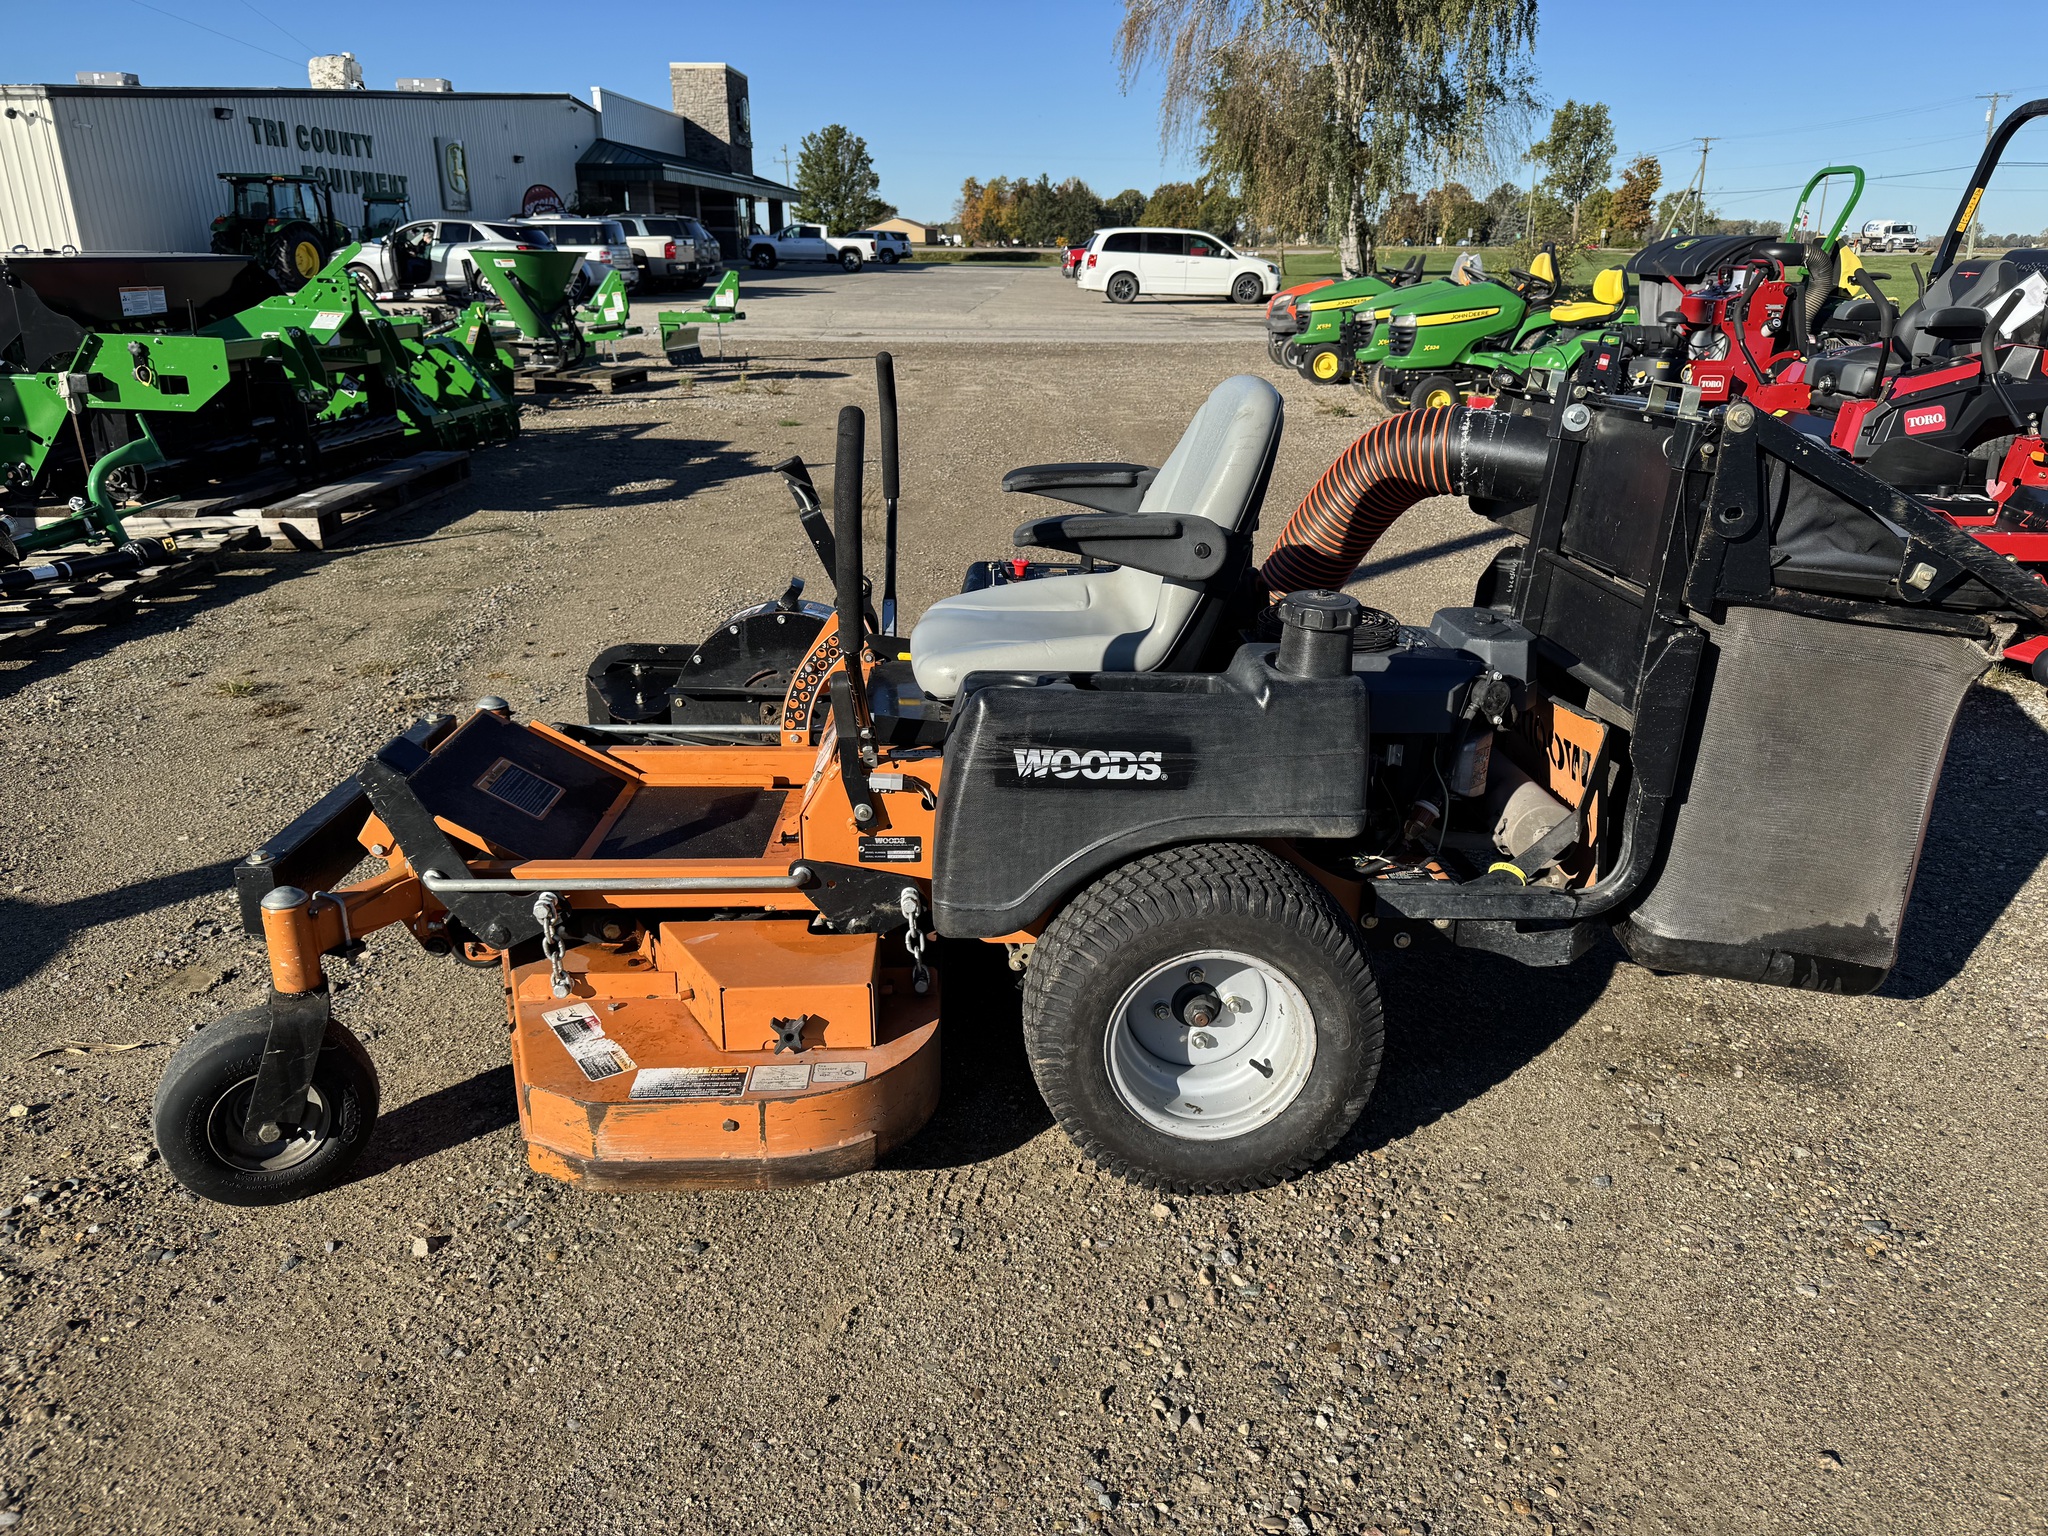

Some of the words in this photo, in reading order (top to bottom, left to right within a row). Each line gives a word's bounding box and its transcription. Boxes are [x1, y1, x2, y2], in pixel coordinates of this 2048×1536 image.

[248, 116, 288, 148] TRI
[295, 124, 373, 158] COUNTY
[1450, 312, 1468, 320] JOHN
[1468, 310, 1489, 318] DEERE
[1700, 380, 1722, 388] TORO
[1907, 413, 1943, 428] TORO
[1013, 748, 1162, 781] WOODS
